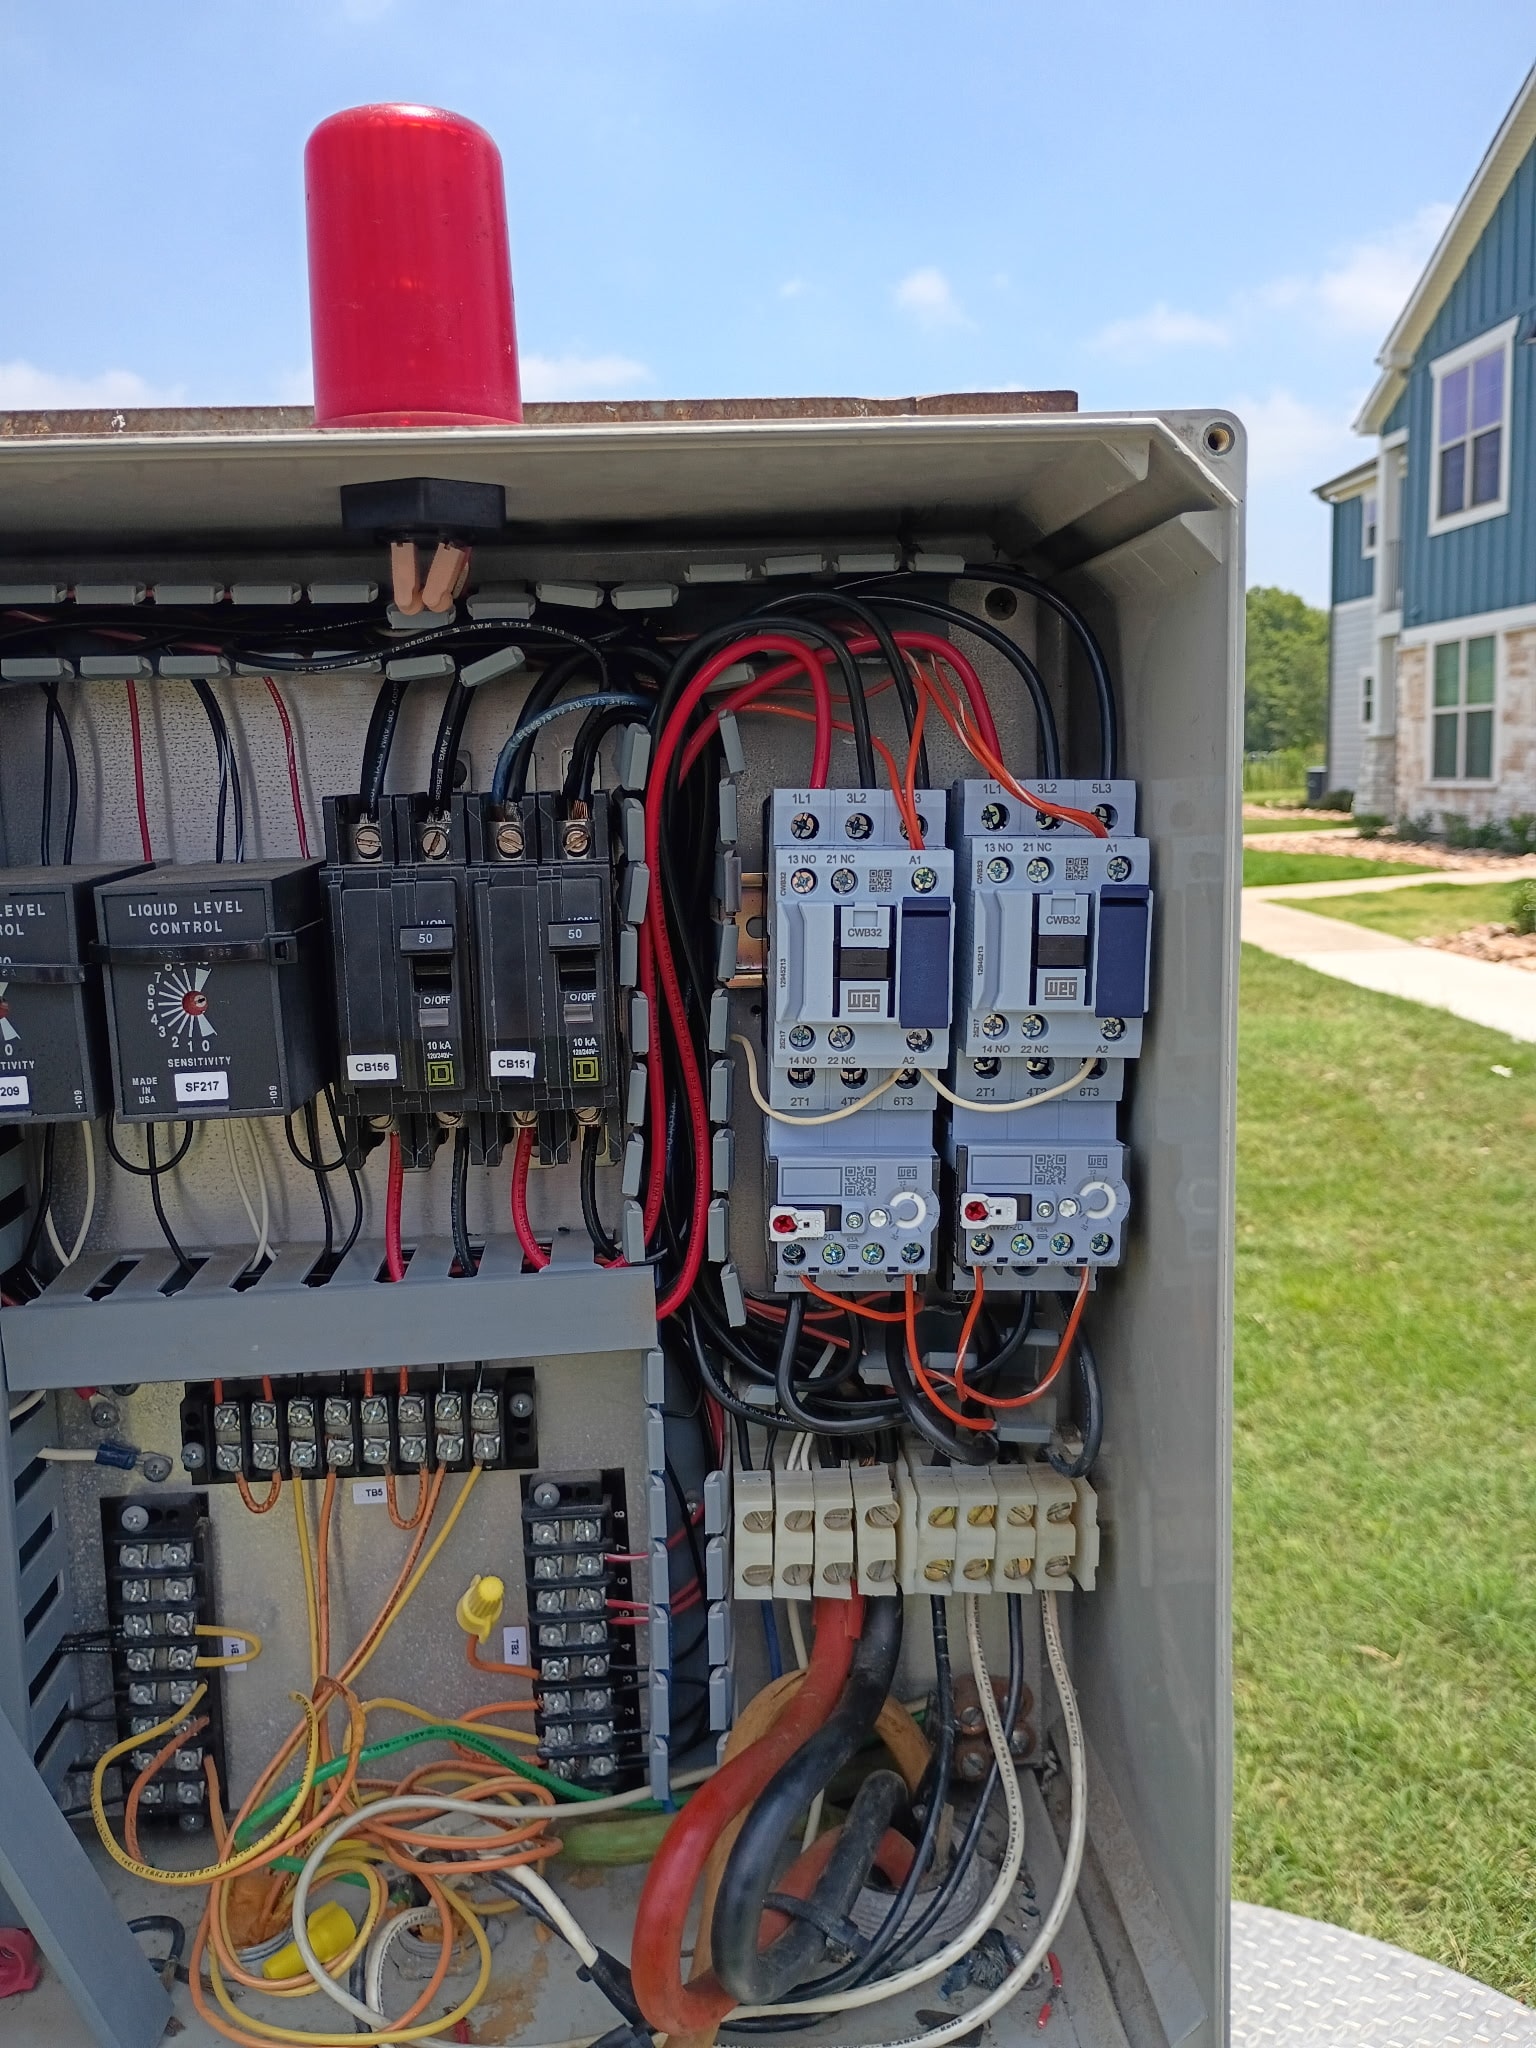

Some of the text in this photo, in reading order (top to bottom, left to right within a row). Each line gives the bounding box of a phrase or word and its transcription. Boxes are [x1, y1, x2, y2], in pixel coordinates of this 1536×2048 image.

[1037, 784, 1058, 794] 3L2
[1091, 784, 1112, 794] 5L3
[792, 794, 811, 804] 1L1
[846, 793, 867, 804] 3L2
[984, 843, 1013, 852] 13 NO
[1023, 843, 1052, 852] 21 NC
[1105, 844, 1118, 853] A1
[788, 855, 817, 864] 13 NO
[826, 855, 855, 864] 21 NC
[909, 855, 921, 865] A1
[976, 860, 984, 885] CWB32
[0, 903, 46, 917] EVEL
[128, 901, 244, 917] LIQUID LEVEL
[1046, 916, 1081, 925] CWB32
[150, 921, 223, 935] CONTROL
[847, 928, 882, 937] CWB32
[418, 933, 433, 944] 50
[568, 928, 582, 939] 50
[154, 972, 161, 983] 7
[147, 984, 156, 996] 6
[147, 999, 154, 1010] 5
[150, 1014, 158, 1025] 4
[158, 1026, 166, 1038] 3
[172, 1036, 179, 1048] 2
[188, 1041, 193, 1053] 1
[202, 1040, 210, 1052] 0
[427, 1040, 453, 1050] 10 kA
[573, 1037, 598, 1047] 10 kA
[5, 1044, 13, 1056] 0
[982, 1046, 1010, 1054] 14 NO
[1020, 1045, 1049, 1054] 22 NC
[1096, 1046, 1108, 1054] A2
[167, 1056, 232, 1068] SENSITIVITY
[498, 1058, 530, 1069] CB151
[789, 1056, 817, 1065] 14 NO
[827, 1056, 856, 1065] 22 NC
[902, 1057, 915, 1065] A2
[355, 1061, 390, 1073] CB156
[132, 1077, 158, 1086] MADE
[142, 1086, 151, 1095] IN
[185, 1081, 220, 1093] SF217
[1079, 1087, 1100, 1097] 6T3
[976, 1088, 995, 1097] 2T1
[139, 1095, 156, 1104] USA
[790, 1097, 810, 1107] 2T1
[893, 1097, 913, 1106] 6T3
[365, 1488, 383, 1497] TB5
[614, 1510, 625, 1519] 8
[616, 1544, 628, 1552] 7
[617, 1577, 628, 1585] 6
[511, 1639, 519, 1656] TB2
[621, 1643, 631, 1651] 4
[622, 1675, 633, 1683] 3
[624, 1707, 635, 1715] 2
